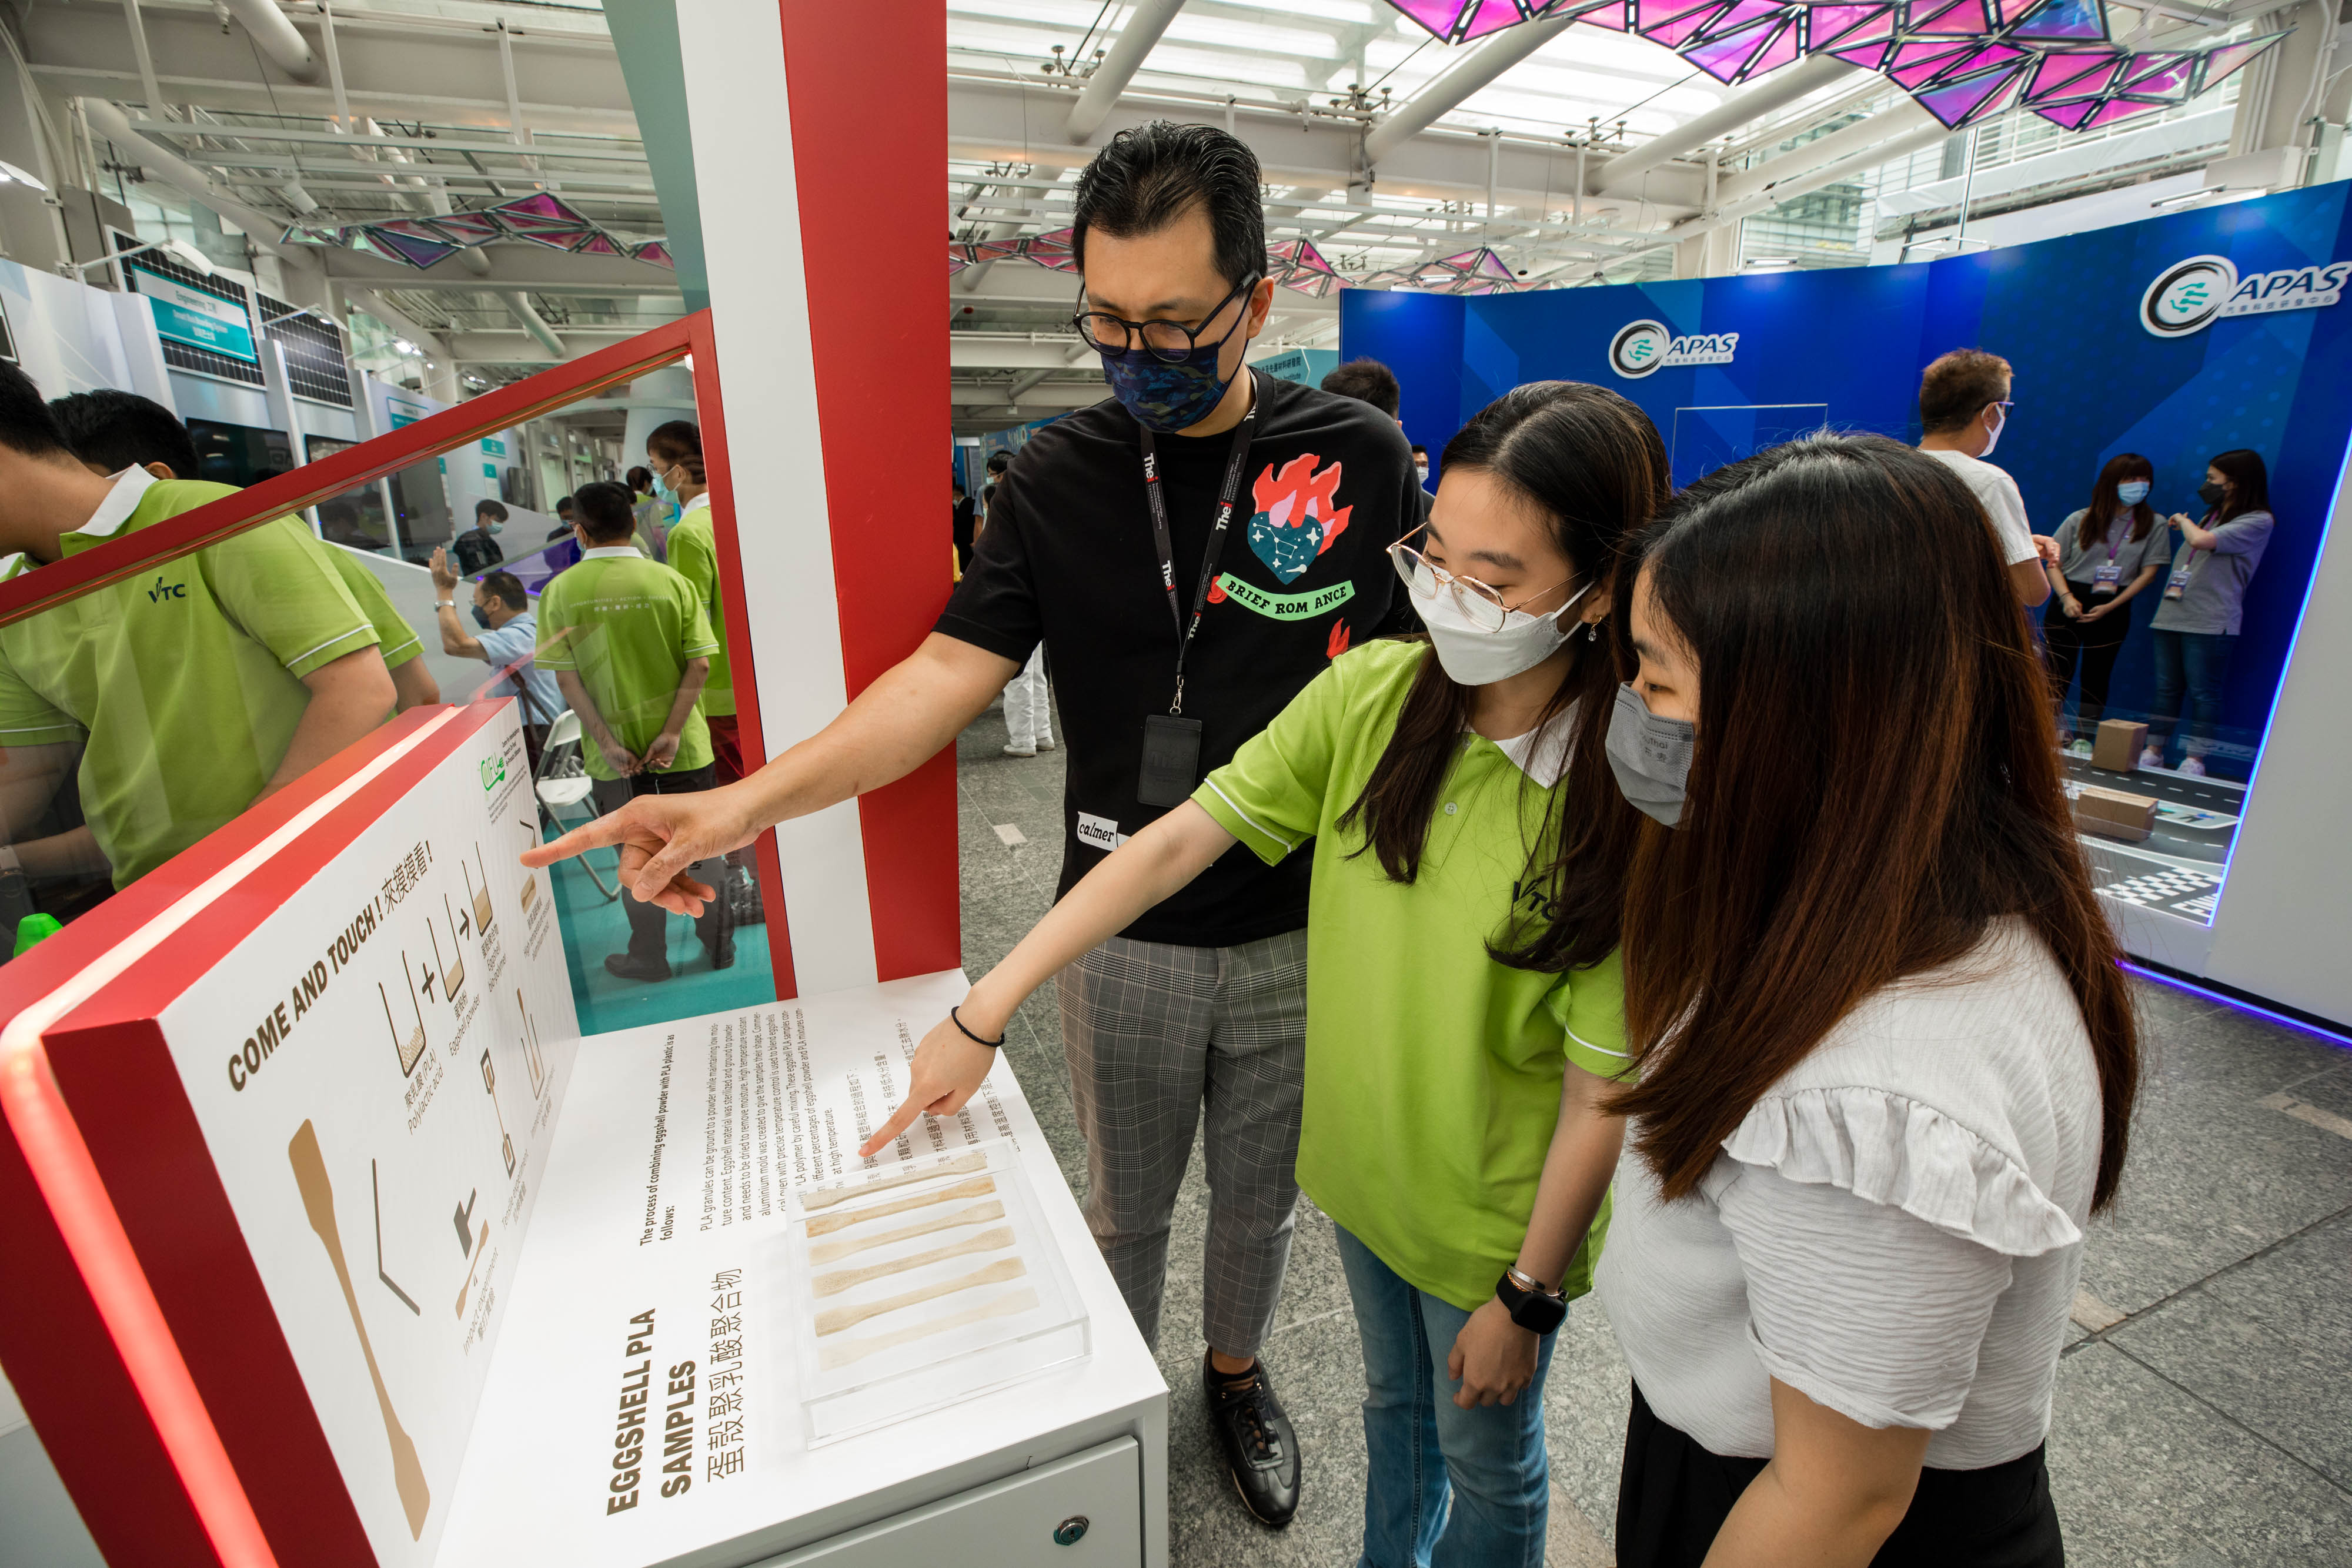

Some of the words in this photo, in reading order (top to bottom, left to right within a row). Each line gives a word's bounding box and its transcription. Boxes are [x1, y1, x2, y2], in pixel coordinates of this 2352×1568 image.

[2229, 266, 2348, 303] APAS
[1666, 336, 1736, 356] APAS
[148, 576, 186, 604] VTC
[1228, 580, 1271, 610] BRIEF
[1275, 601, 1308, 614] ROM
[1314, 586, 1347, 610] ANCE
[1079, 822, 1114, 842] calmer
[487, 941, 501, 974] Eggshell
[228, 1001, 291, 1091] COME
[292, 960, 327, 1022] AND
[449, 1018, 467, 1057] Eggshell
[465, 992, 480, 1025] powder
[723, 1024, 734, 1042] powder
[739, 1016, 747, 1036] resistant
[766, 1014, 778, 1035] eggshells
[780, 1020, 791, 1039] samples
[796, 1019, 805, 1039] mixtures
[709, 1037, 717, 1046] low
[752, 1032, 763, 1049] shape.
[766, 1036, 777, 1051] blend
[782, 1039, 791, 1050] PLA
[797, 1039, 807, 1050] PLA
[662, 1045, 673, 1064] plastic
[707, 1045, 720, 1076] maintaining
[723, 1048, 734, 1067] ground
[739, 1036, 749, 1067] temperature
[753, 1049, 762, 1062] their
[783, 1050, 796, 1072] eggshell
[798, 1050, 808, 1060] and
[660, 1064, 670, 1076] PLA
[723, 1068, 732, 1078] and
[738, 1067, 750, 1081] High
[753, 1062, 765, 1084] samples
[768, 1057, 779, 1070] used
[800, 1061, 813, 1081] powder
[405, 1071, 423, 1111] 聚乳酸
[422, 1048, 437, 1080] (PLA)
[659, 1076, 669, 1089] with
[706, 1077, 716, 1092] while
[754, 1084, 764, 1095] the
[769, 1075, 780, 1095] control
[786, 1072, 795, 1089] These
[408, 1084, 433, 1136] Polylactic
[432, 1063, 443, 1089] acid
[657, 1091, 668, 1114] powder
[722, 1079, 732, 1105] sterilized
[739, 1081, 748, 1108] moisture.
[755, 1095, 767, 1108] give
[787, 1089, 799, 1111] mixing.
[801, 1082, 816, 1106] eggshell
[706, 1094, 717, 1115] powder
[724, 1105, 732, 1118] was
[773, 1096, 785, 1134] temperature
[654, 1114, 666, 1142] eggshell
[721, 1118, 731, 1144] material
[755, 1116, 766, 1139] created
[788, 1111, 800, 1133] careful
[824, 1108, 837, 1149] temperature.
[704, 1129, 717, 1154] ground
[791, 1134, 804, 1143] by
[808, 1114, 823, 1154] percentages
[738, 1141, 750, 1159] dried
[759, 1141, 767, 1154] was
[774, 1135, 788, 1159] precise
[827, 1149, 842, 1166] high
[649, 1144, 665, 1183] combining
[703, 1155, 714, 1165] be
[720, 1145, 734, 1175] Eggshell
[739, 1161, 750, 1171] be
[756, 1155, 768, 1174] mold
[774, 1160, 786, 1176] with
[793, 1144, 807, 1172] polymer
[705, 1165, 713, 1178] can
[740, 1171, 750, 1179] to
[701, 1179, 716, 1212] granules
[721, 1175, 731, 1206] content.
[739, 1181, 750, 1203] needs
[758, 1175, 770, 1216] aluminium
[645, 1194, 657, 1226] process
[721, 1208, 731, 1226] ture
[739, 1205, 751, 1221] and
[659, 1205, 674, 1240] follows:
[700, 1213, 712, 1231] PLA
[640, 1228, 653, 1246] The
[463, 1308, 479, 1357] Impact
[625, 1308, 655, 1357] PLA
[707, 1269, 744, 1482] 蛋殼聚乳酸聚合物
[606, 1359, 650, 1516] EGGSHELL
[660, 1360, 696, 1497] SAMPLES
